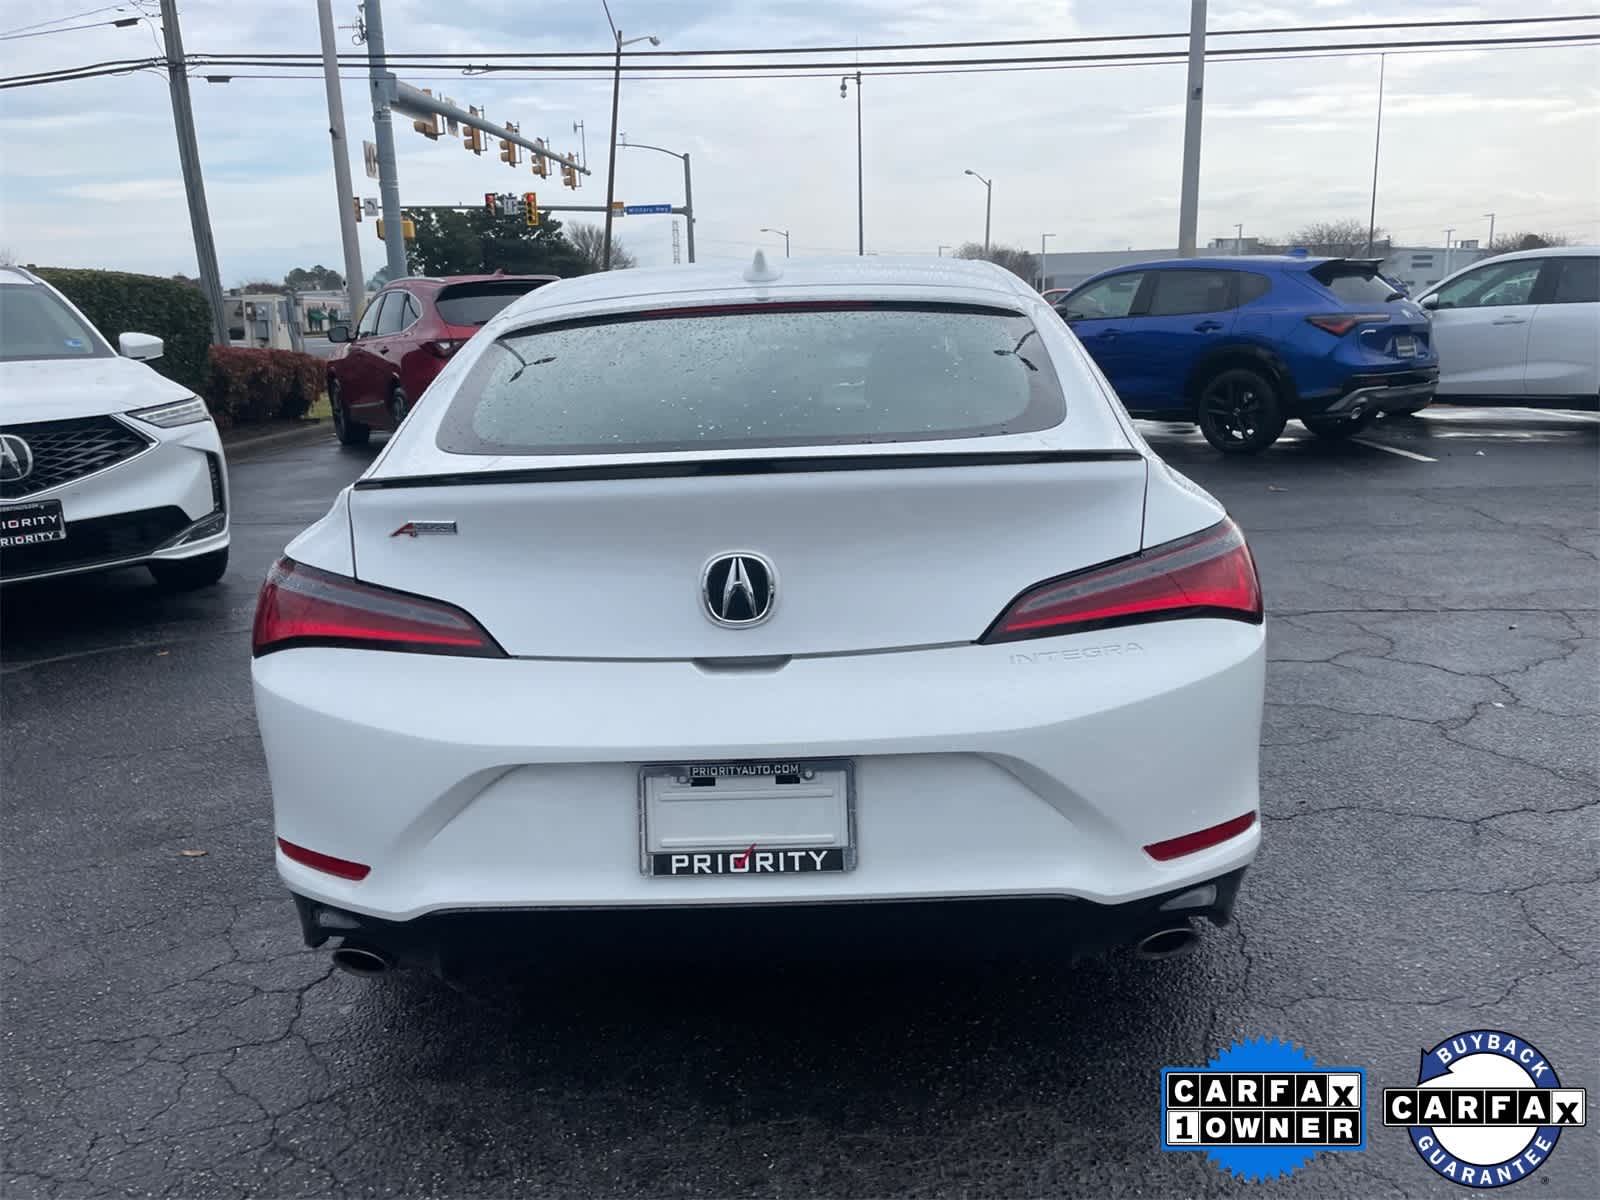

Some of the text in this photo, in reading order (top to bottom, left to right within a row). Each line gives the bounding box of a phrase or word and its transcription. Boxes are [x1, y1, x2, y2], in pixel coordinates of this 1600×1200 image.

[0, 514, 57, 530] IORITY
[0, 531, 54, 547] RIORITY
[692, 764, 799, 777] PRIORITYAUTO.COM
[671, 851, 828, 875] PRIORITY
